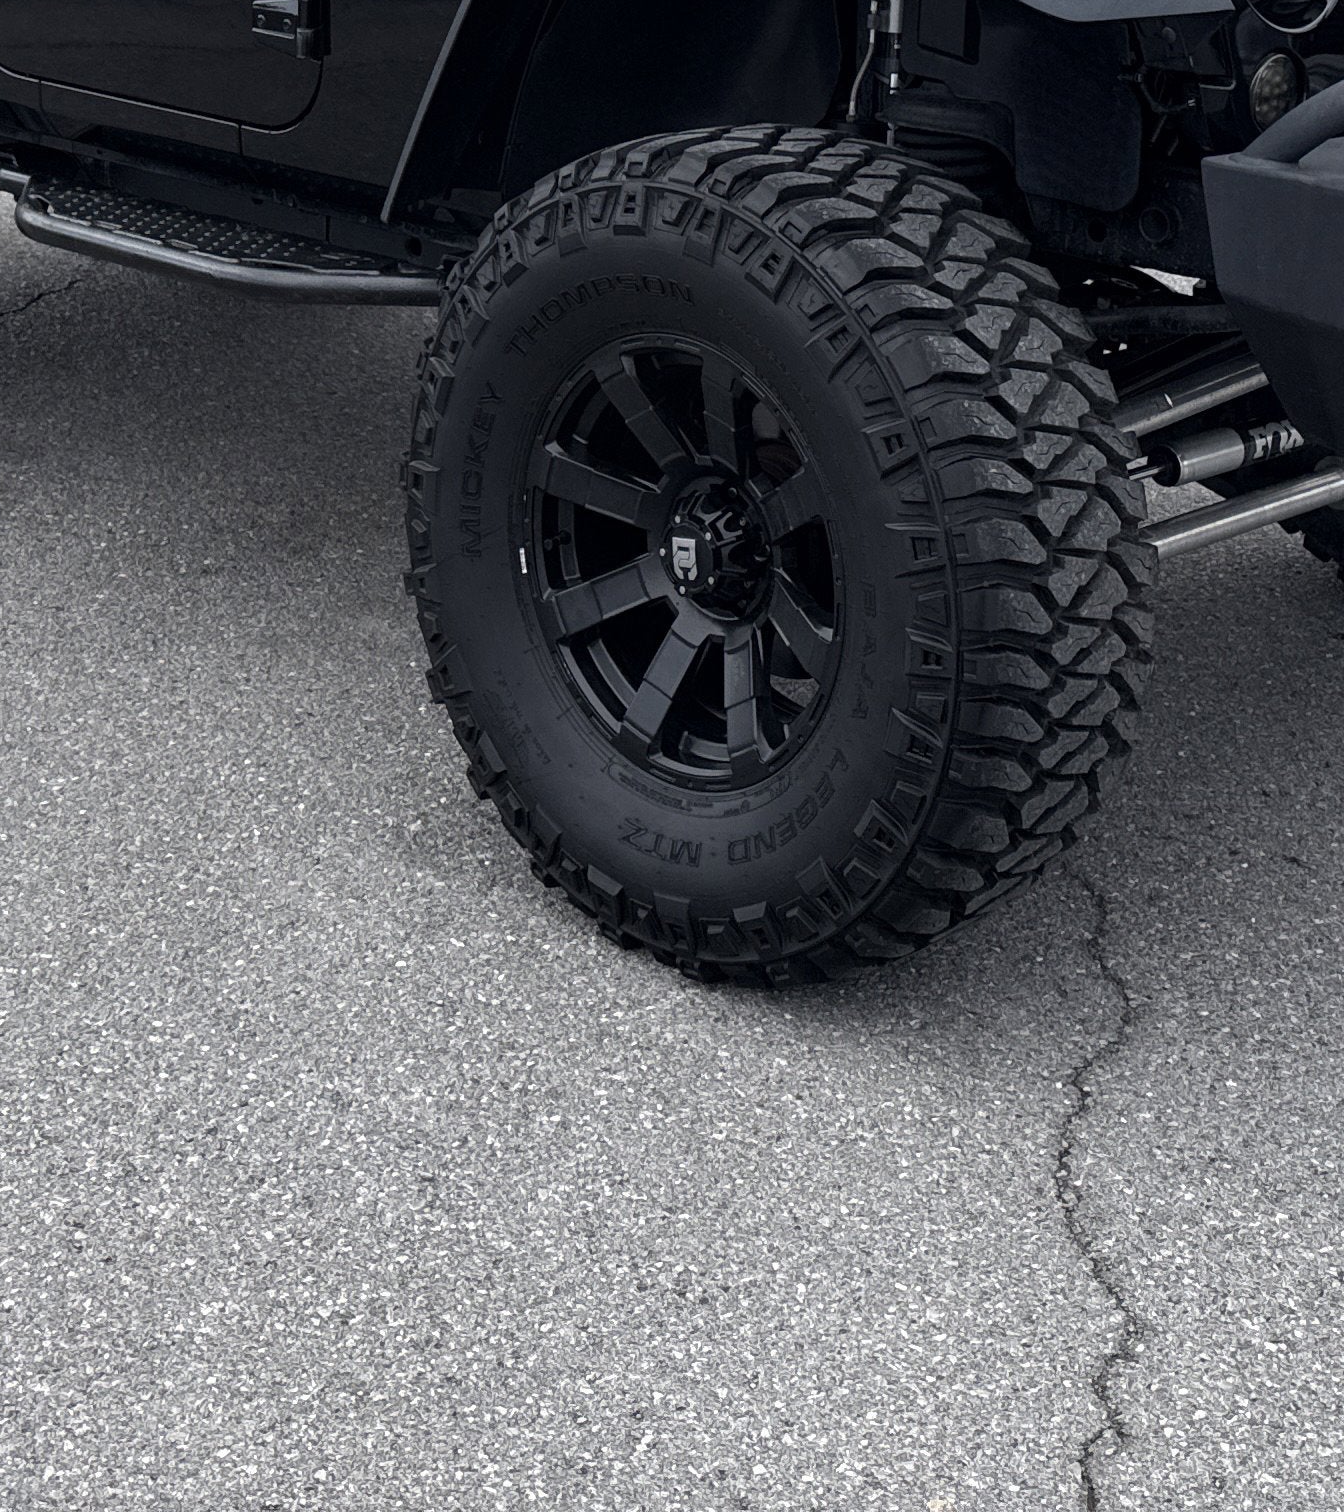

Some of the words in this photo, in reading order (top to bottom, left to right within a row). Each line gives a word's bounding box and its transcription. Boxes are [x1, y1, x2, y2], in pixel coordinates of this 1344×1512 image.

[506, 271, 697, 358] THOMPSON
[458, 382, 504, 559] MICKEY
[618, 816, 703, 867] MTZ
[728, 747, 850, 866] LEGEND
